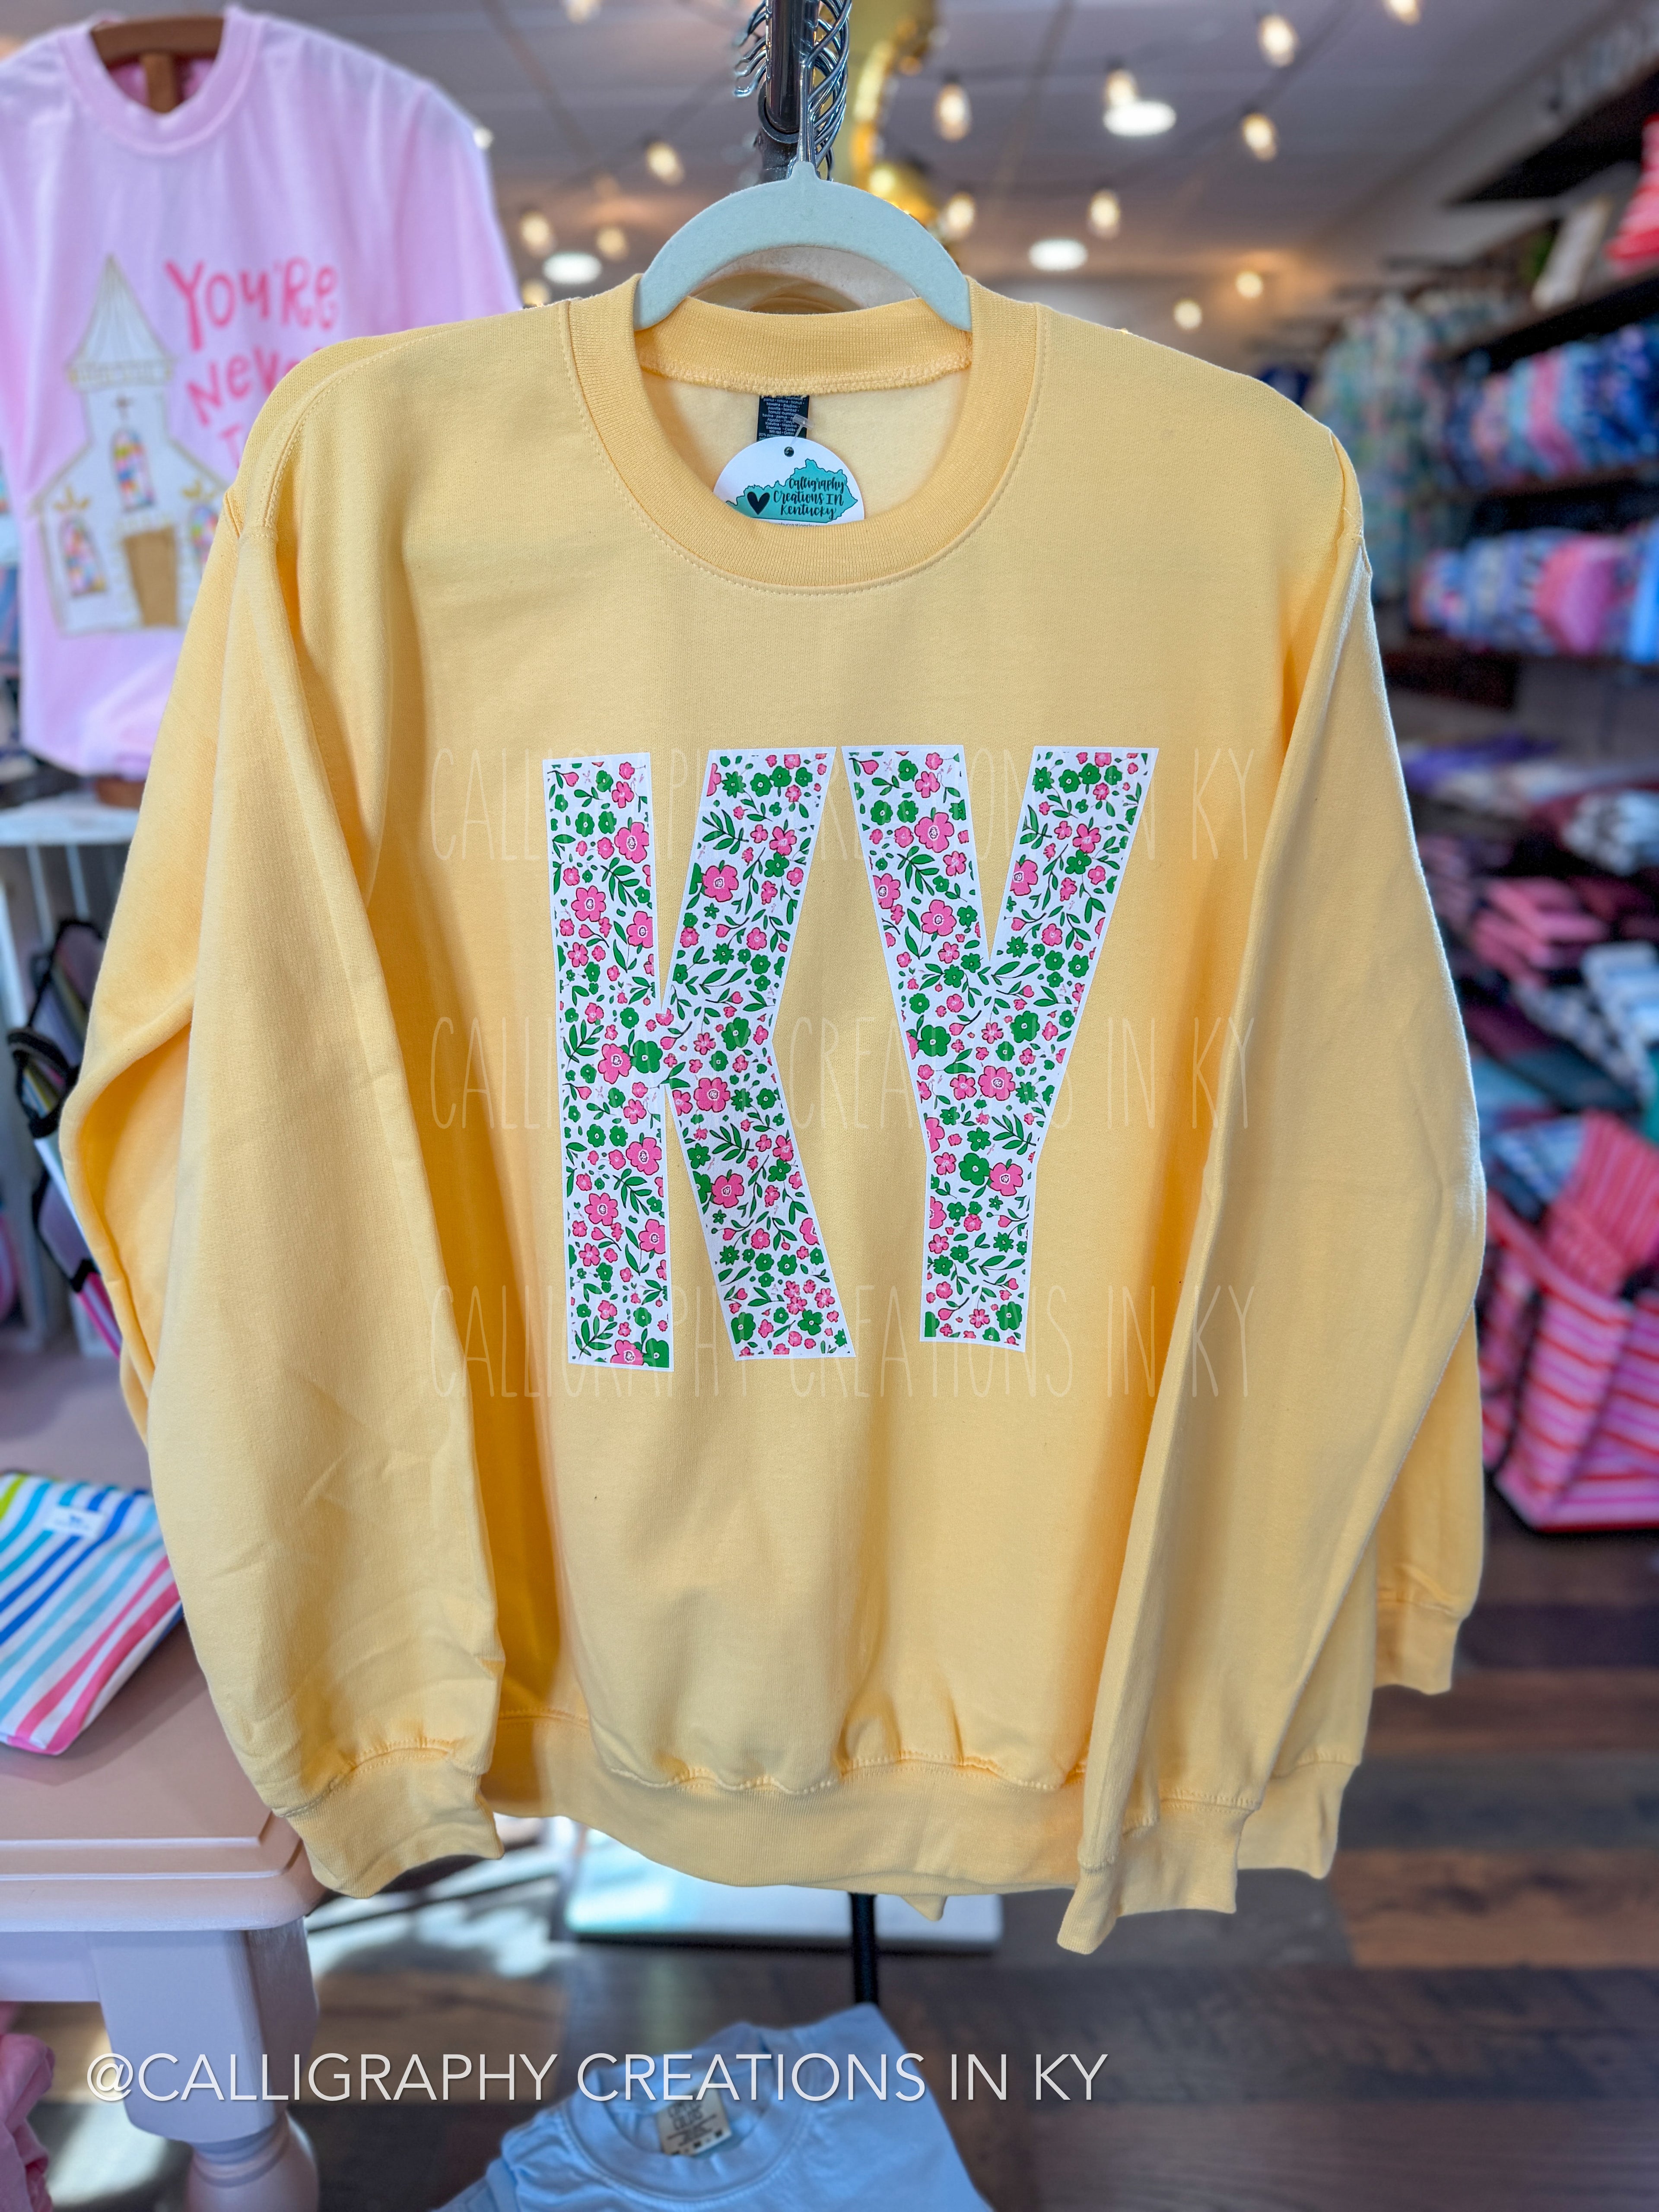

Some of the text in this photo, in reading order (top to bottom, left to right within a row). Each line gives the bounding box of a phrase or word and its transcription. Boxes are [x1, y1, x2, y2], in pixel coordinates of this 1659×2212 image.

[788, 476, 845, 494] Calligraphy
[773, 490, 824, 505] Creations
[780, 504, 837, 520] Kentucky
[543, 744, 1158, 1372] KY
